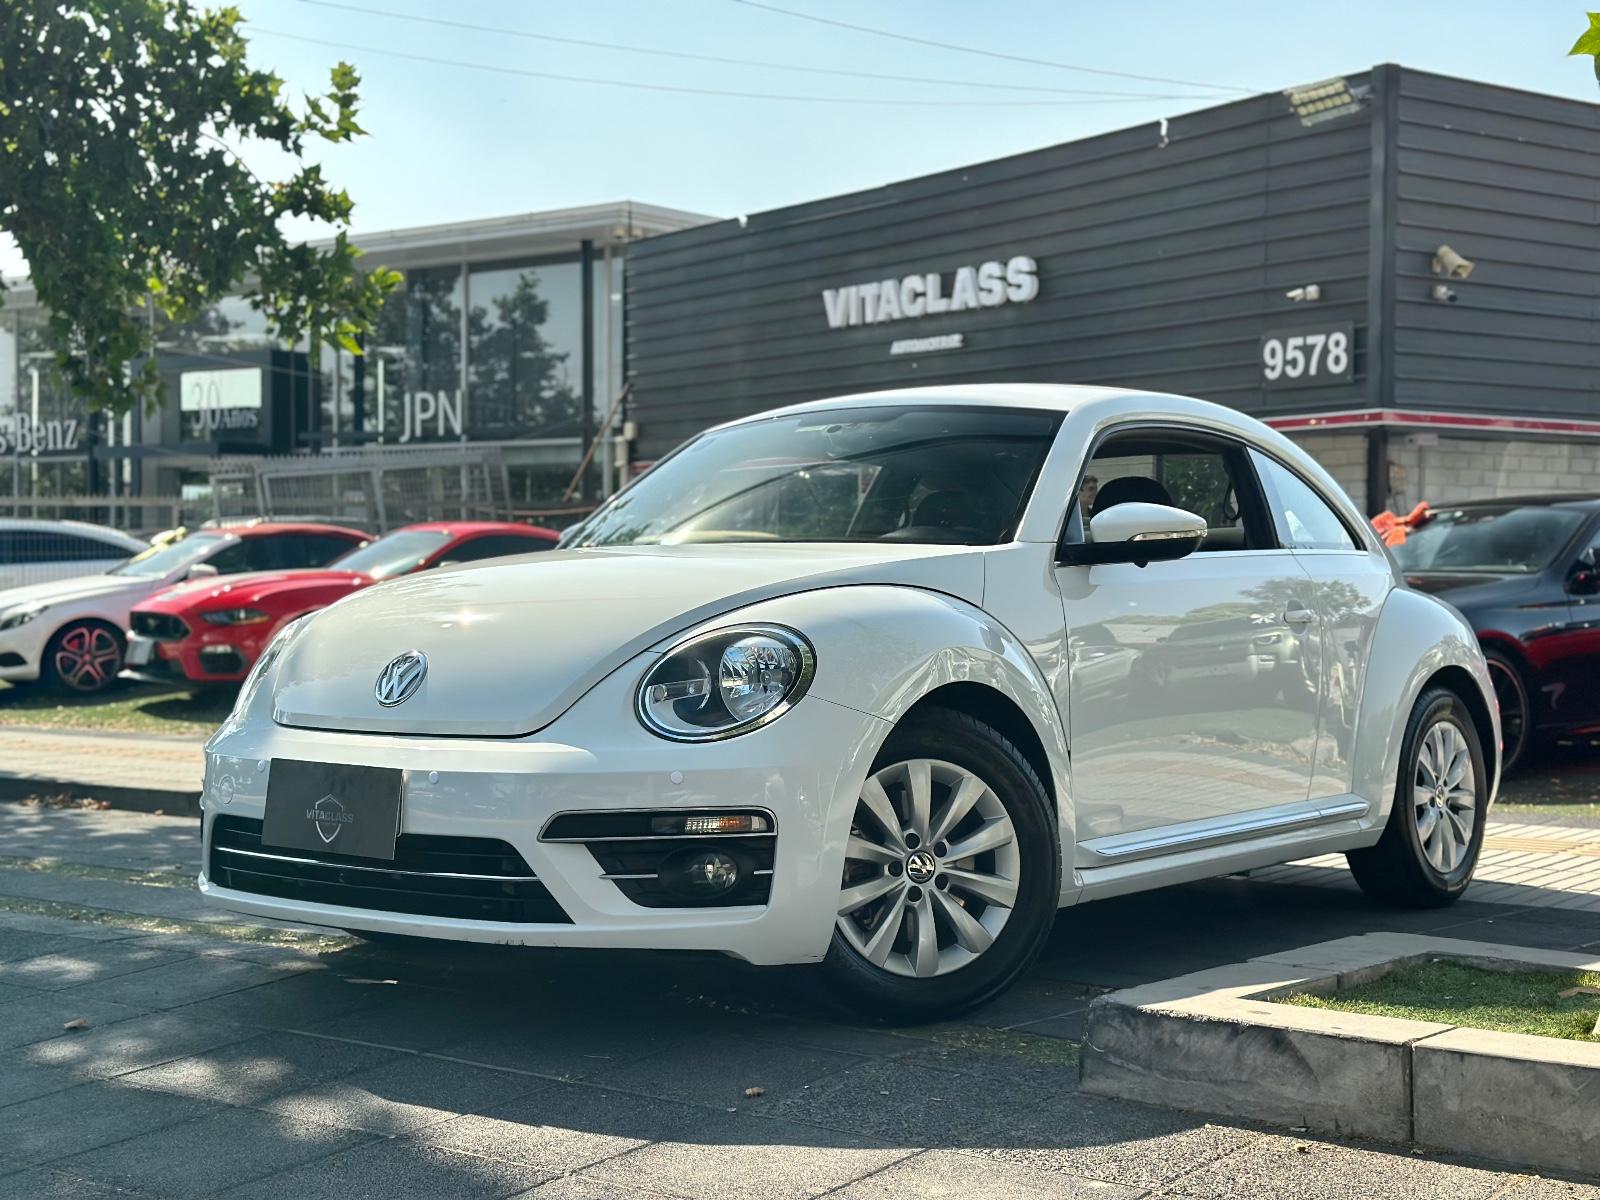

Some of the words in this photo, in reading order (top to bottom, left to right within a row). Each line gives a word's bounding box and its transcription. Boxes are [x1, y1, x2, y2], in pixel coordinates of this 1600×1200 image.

[822, 256, 1039, 328] VITACLASS
[1263, 331, 1348, 380] 9578
[399, 389, 462, 443] JPN
[306, 808, 354, 823] VITACLASS
